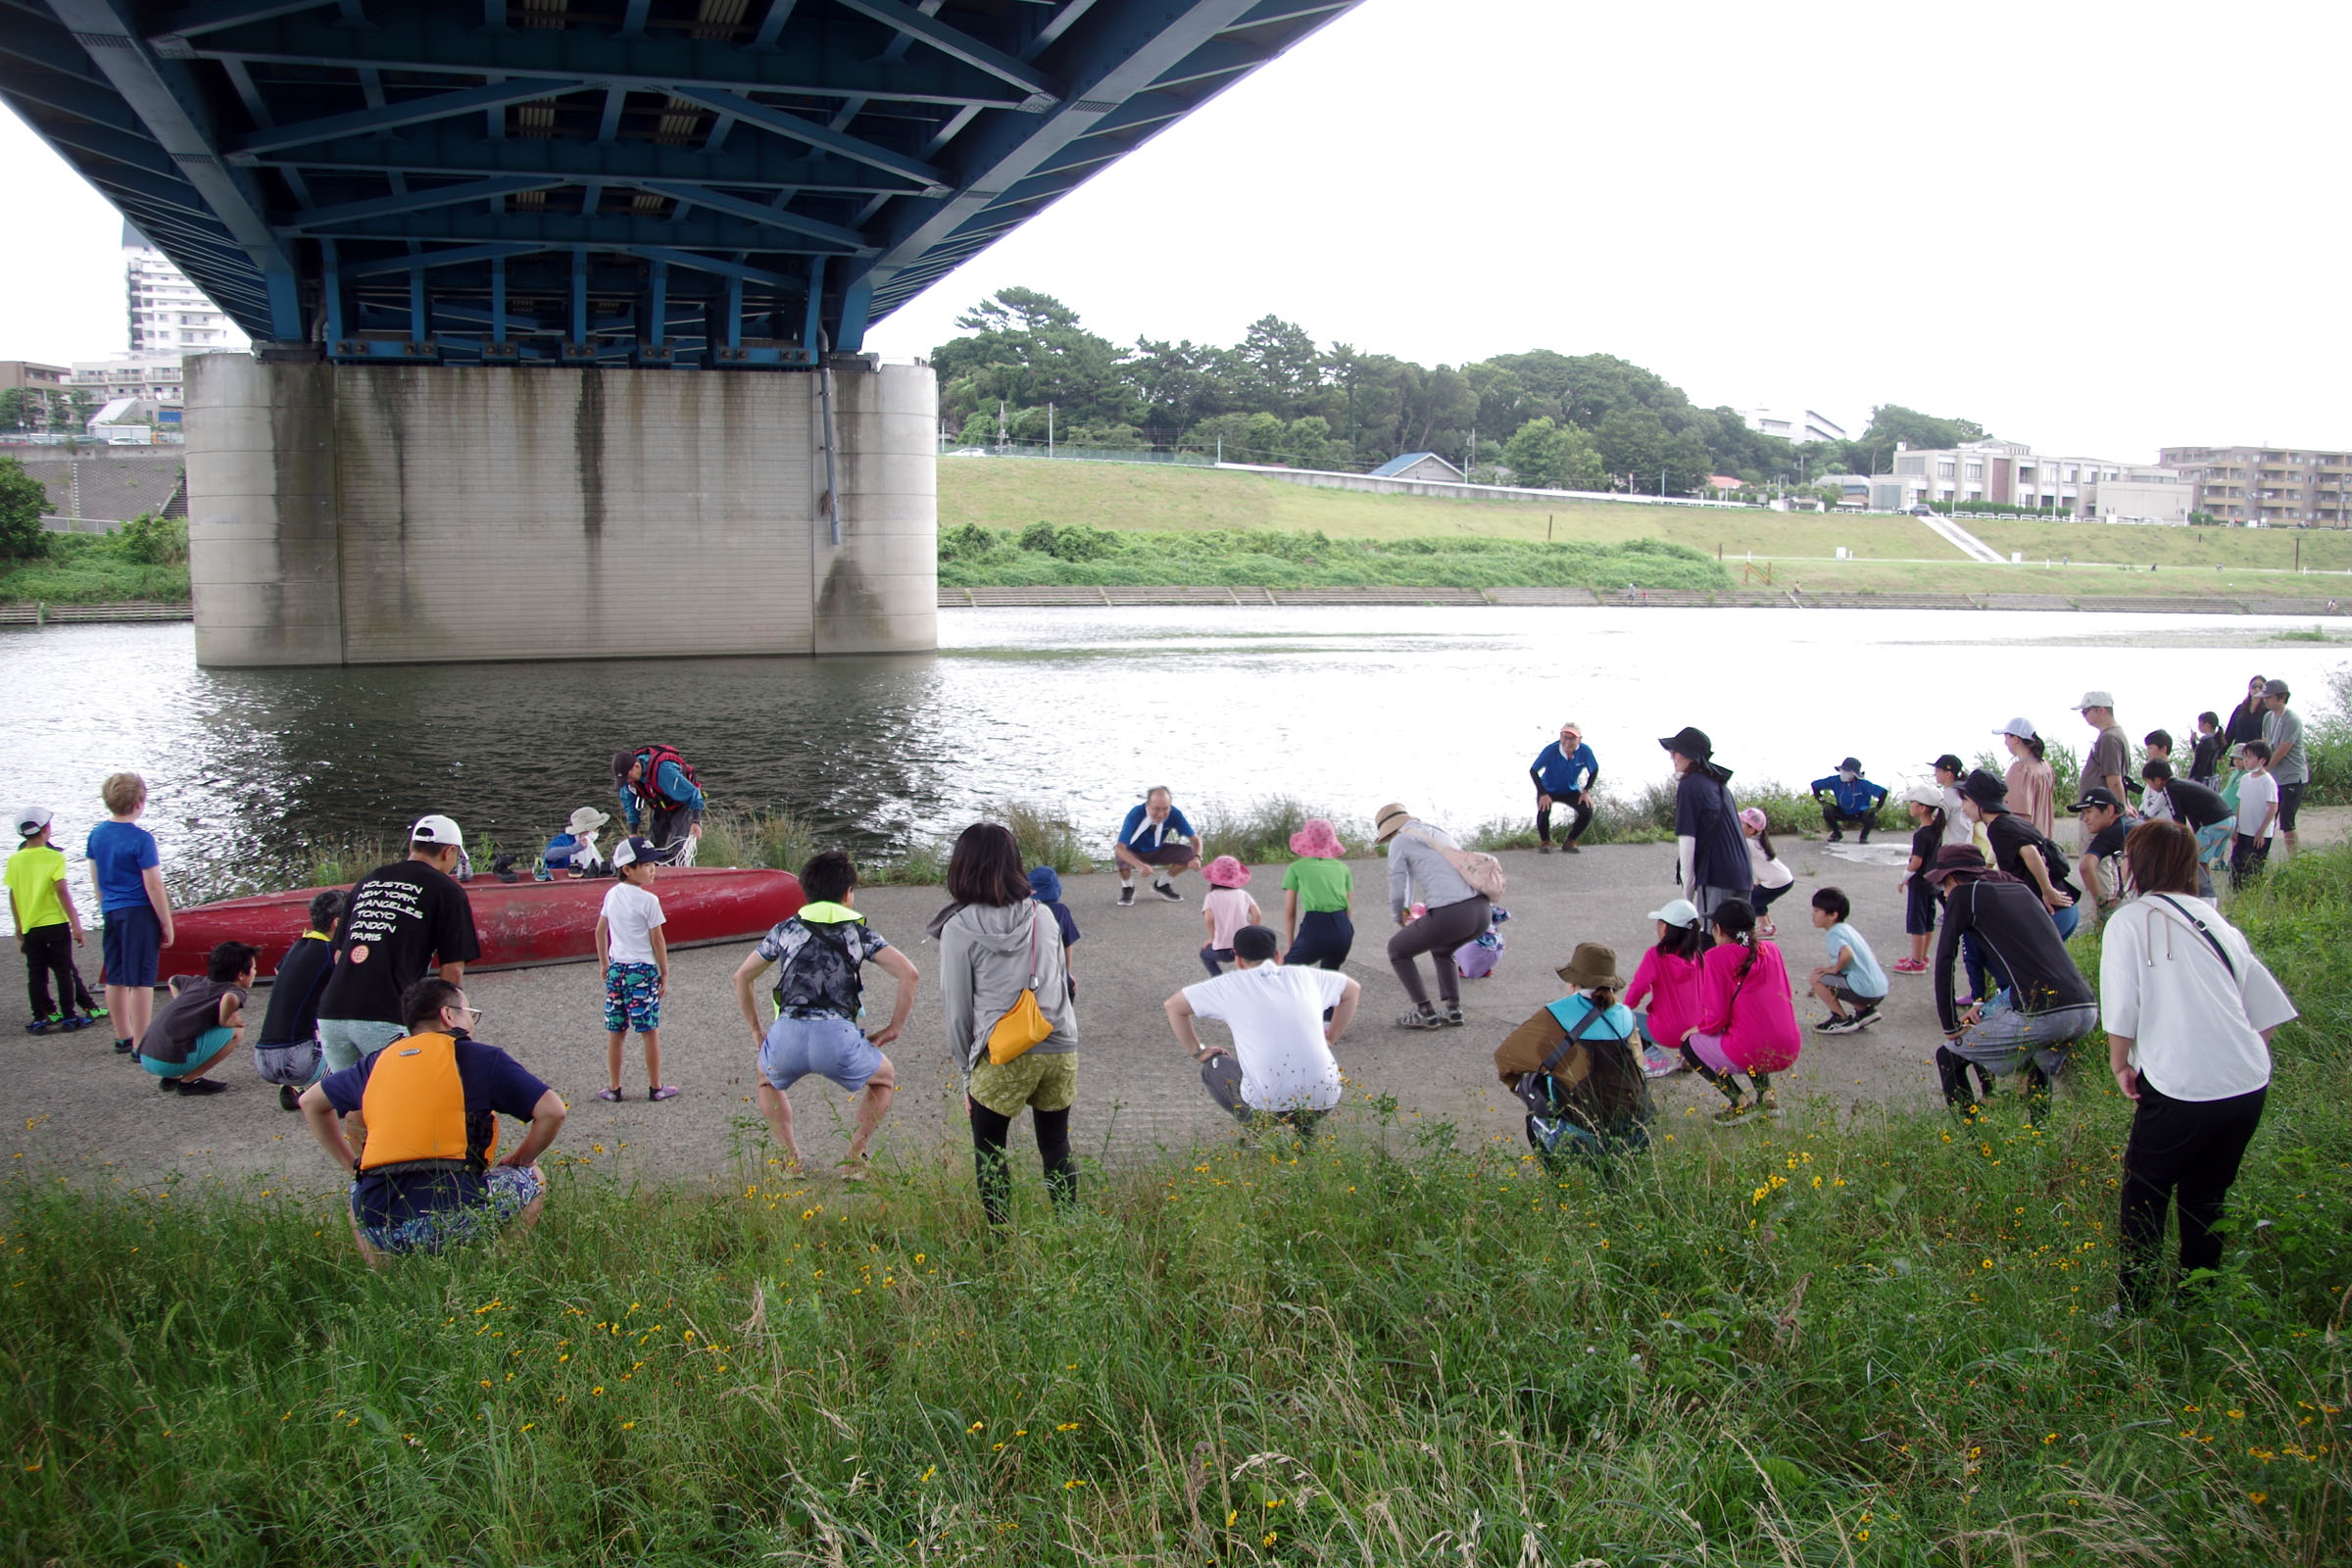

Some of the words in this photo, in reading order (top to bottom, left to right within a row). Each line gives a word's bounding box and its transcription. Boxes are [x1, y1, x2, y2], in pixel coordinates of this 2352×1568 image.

[363, 880, 423, 895] HOUSTON
[357, 890, 383, 901] NEW
[384, 891, 418, 905] YORK
[357, 909, 396, 920] TOKYO
[350, 921, 397, 934] LONDON
[350, 932, 382, 942] PARIS
